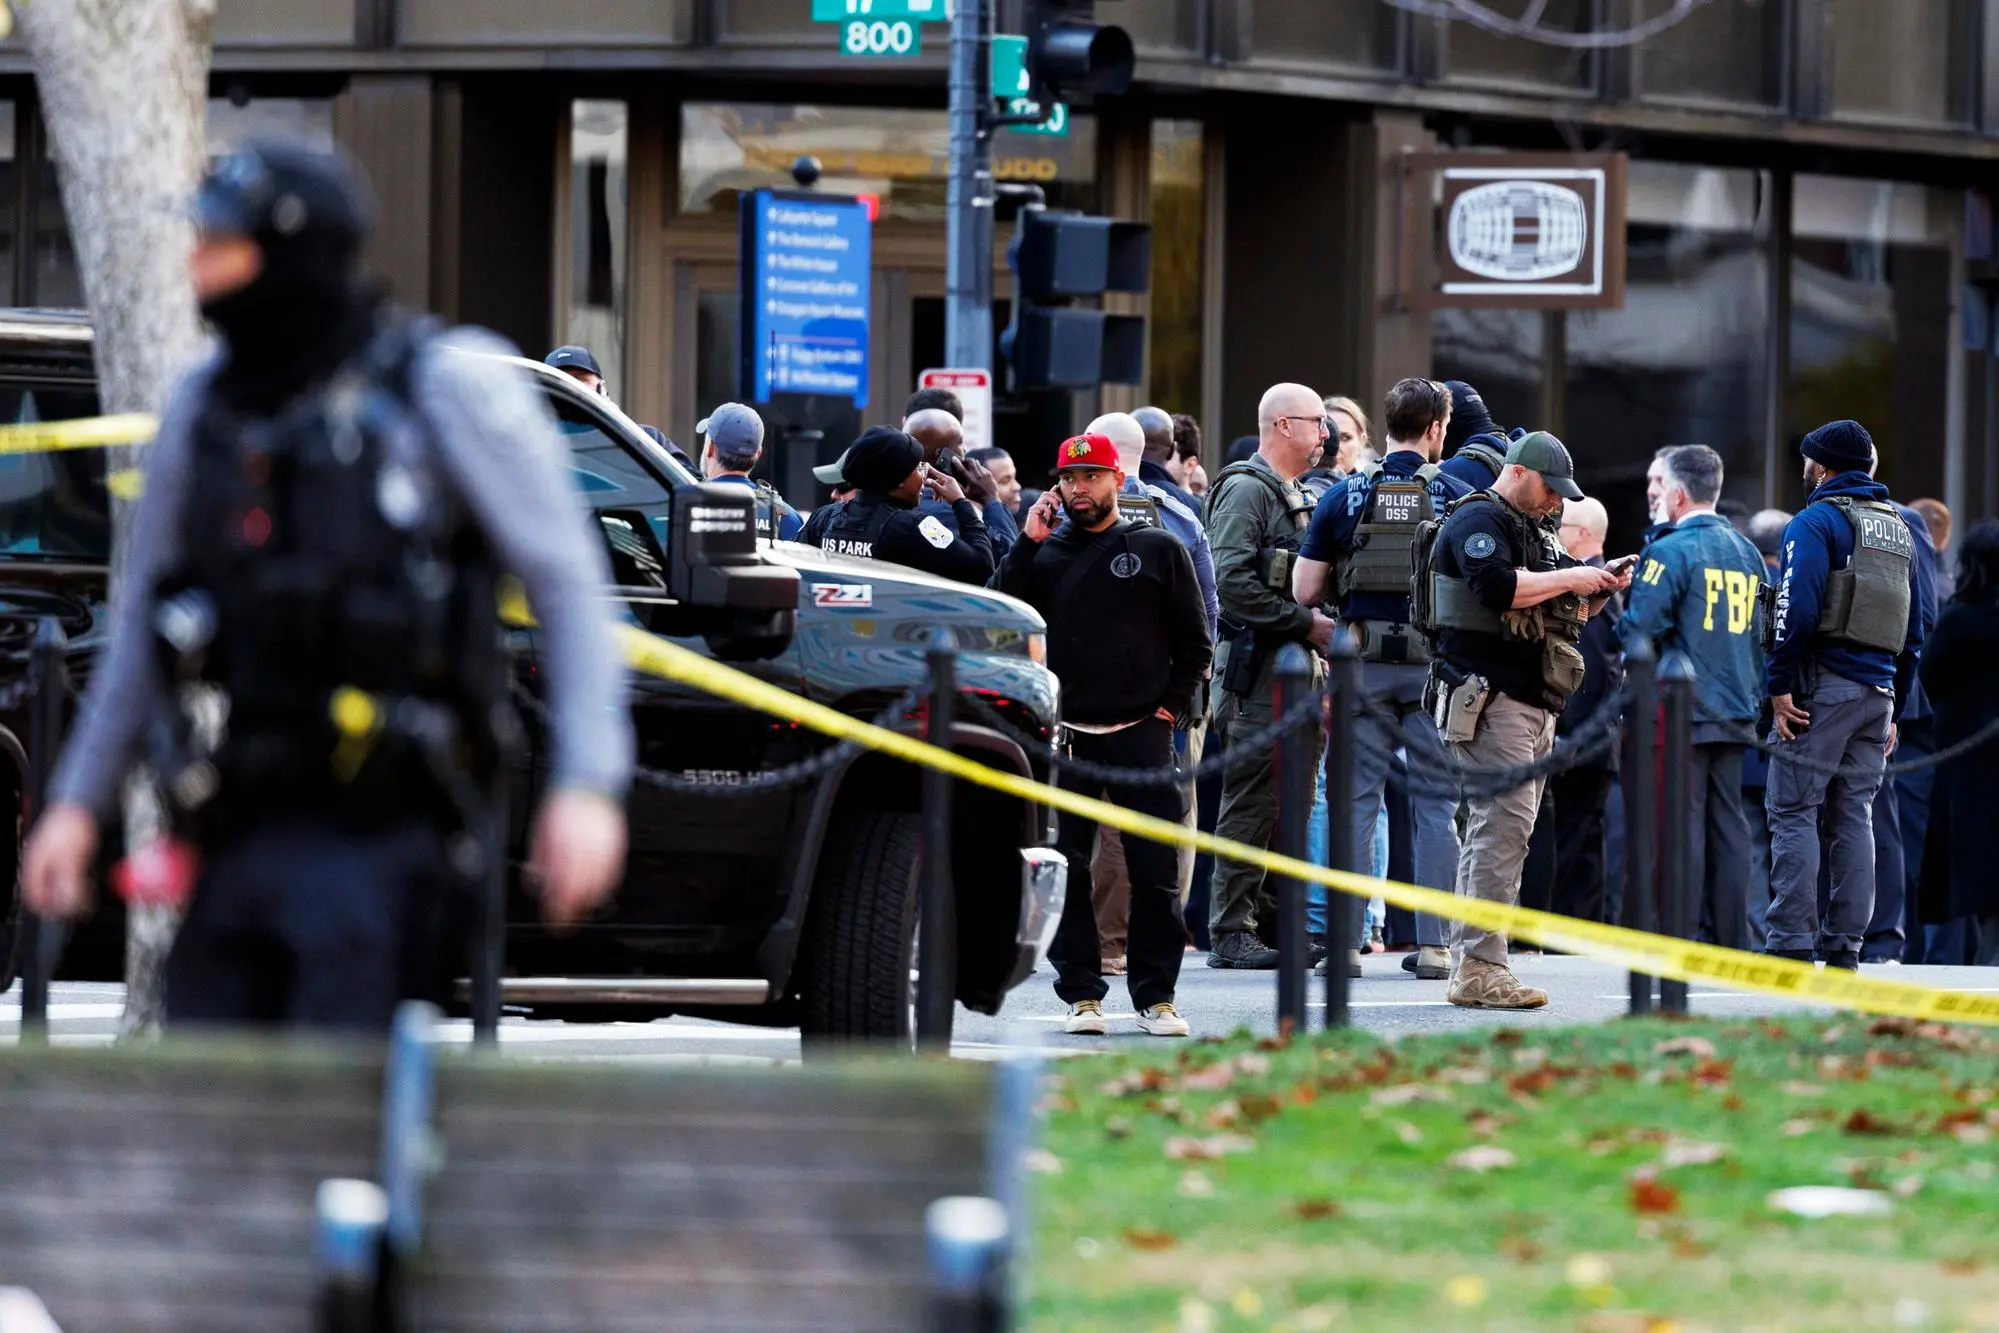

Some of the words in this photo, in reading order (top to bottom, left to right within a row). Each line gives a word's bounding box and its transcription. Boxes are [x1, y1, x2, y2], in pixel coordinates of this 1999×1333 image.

[845, 20, 913, 54] 800
[1377, 494, 1419, 507] POLICE
[1386, 508, 1409, 521] DSS
[1863, 518, 1911, 547] POLICE
[822, 537, 837, 552] US
[838, 539, 873, 557] PARK
[1636, 559, 1666, 586] BI
[1703, 568, 1759, 635] FBI
